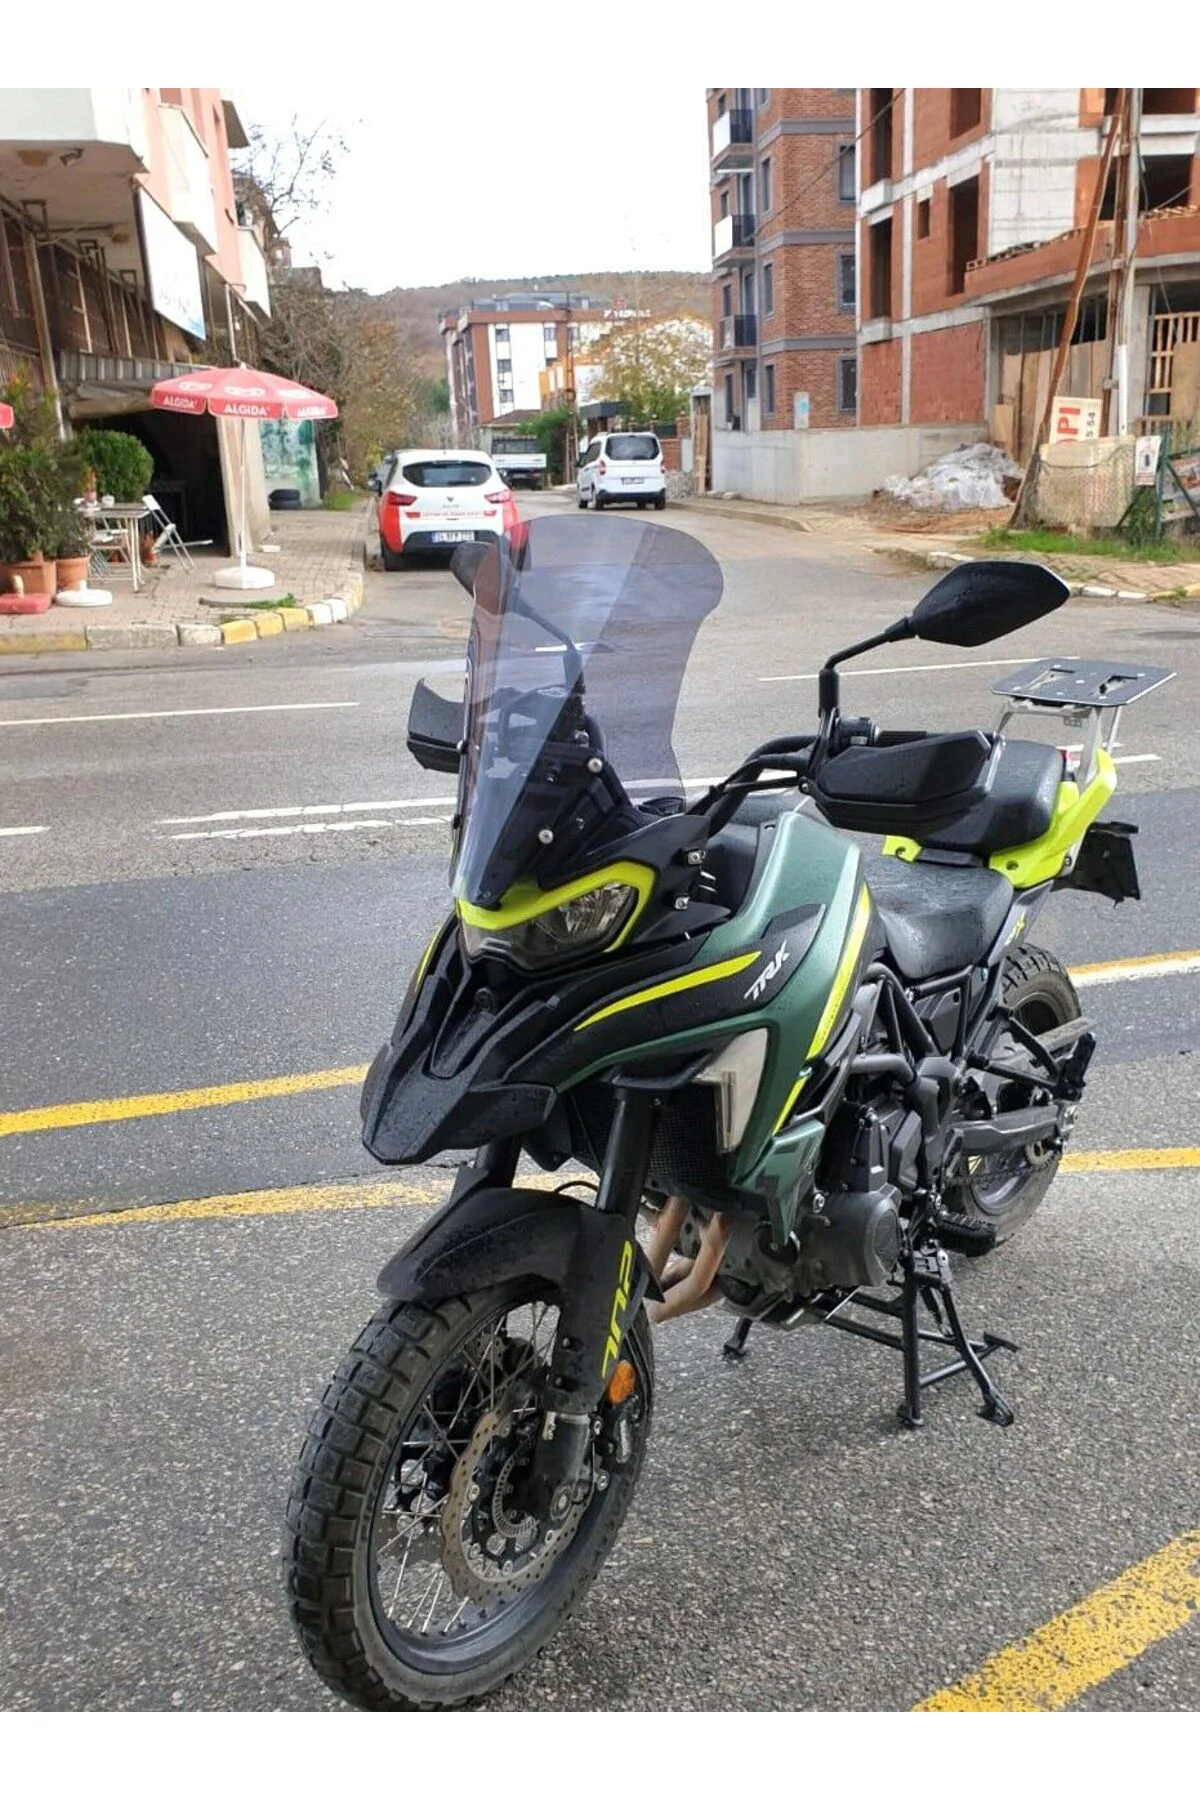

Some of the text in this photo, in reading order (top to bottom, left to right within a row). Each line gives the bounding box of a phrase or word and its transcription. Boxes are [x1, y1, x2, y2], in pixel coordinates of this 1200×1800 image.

[163, 396, 195, 409] ALGIDA
[223, 403, 267, 416] ALGIDA
[743, 939, 791, 1001] TRK
